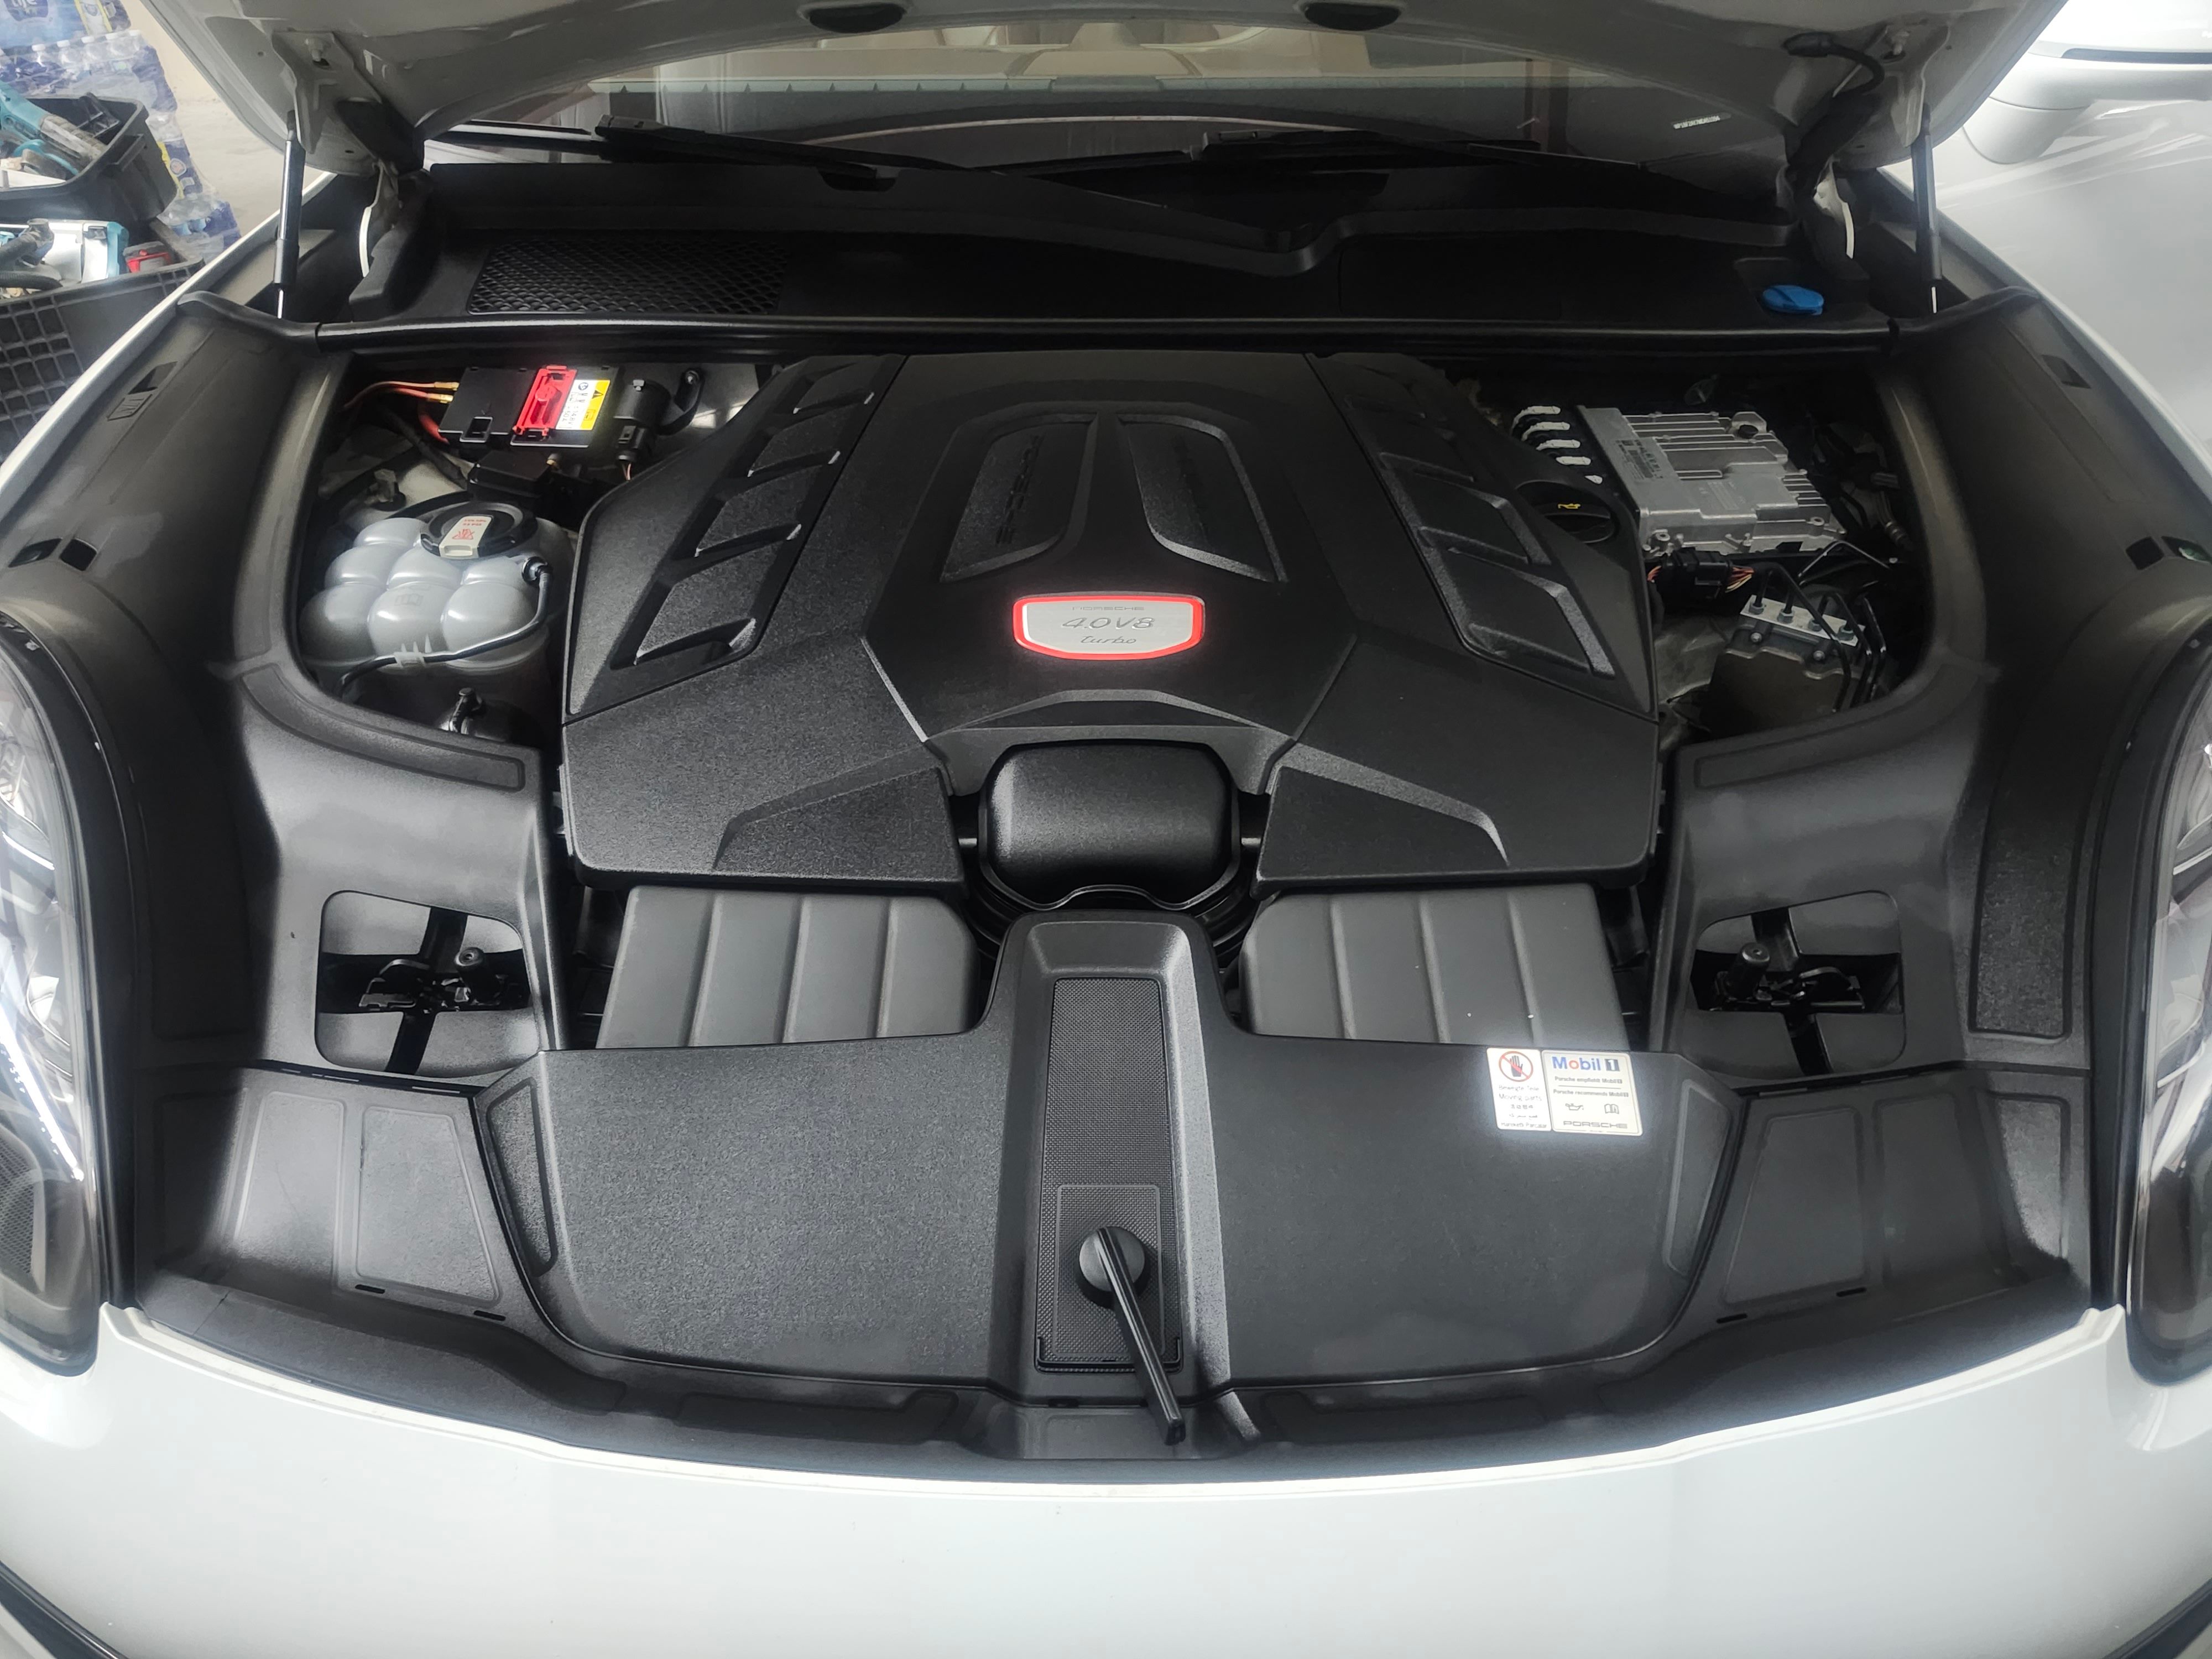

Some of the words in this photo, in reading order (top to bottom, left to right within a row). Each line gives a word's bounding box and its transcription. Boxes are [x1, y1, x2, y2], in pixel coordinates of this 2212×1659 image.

[1552, 1056, 1601, 1071] Mobil
[1606, 1059, 1618, 1071] 1
[1563, 1120, 1627, 1129] PORSCHE
